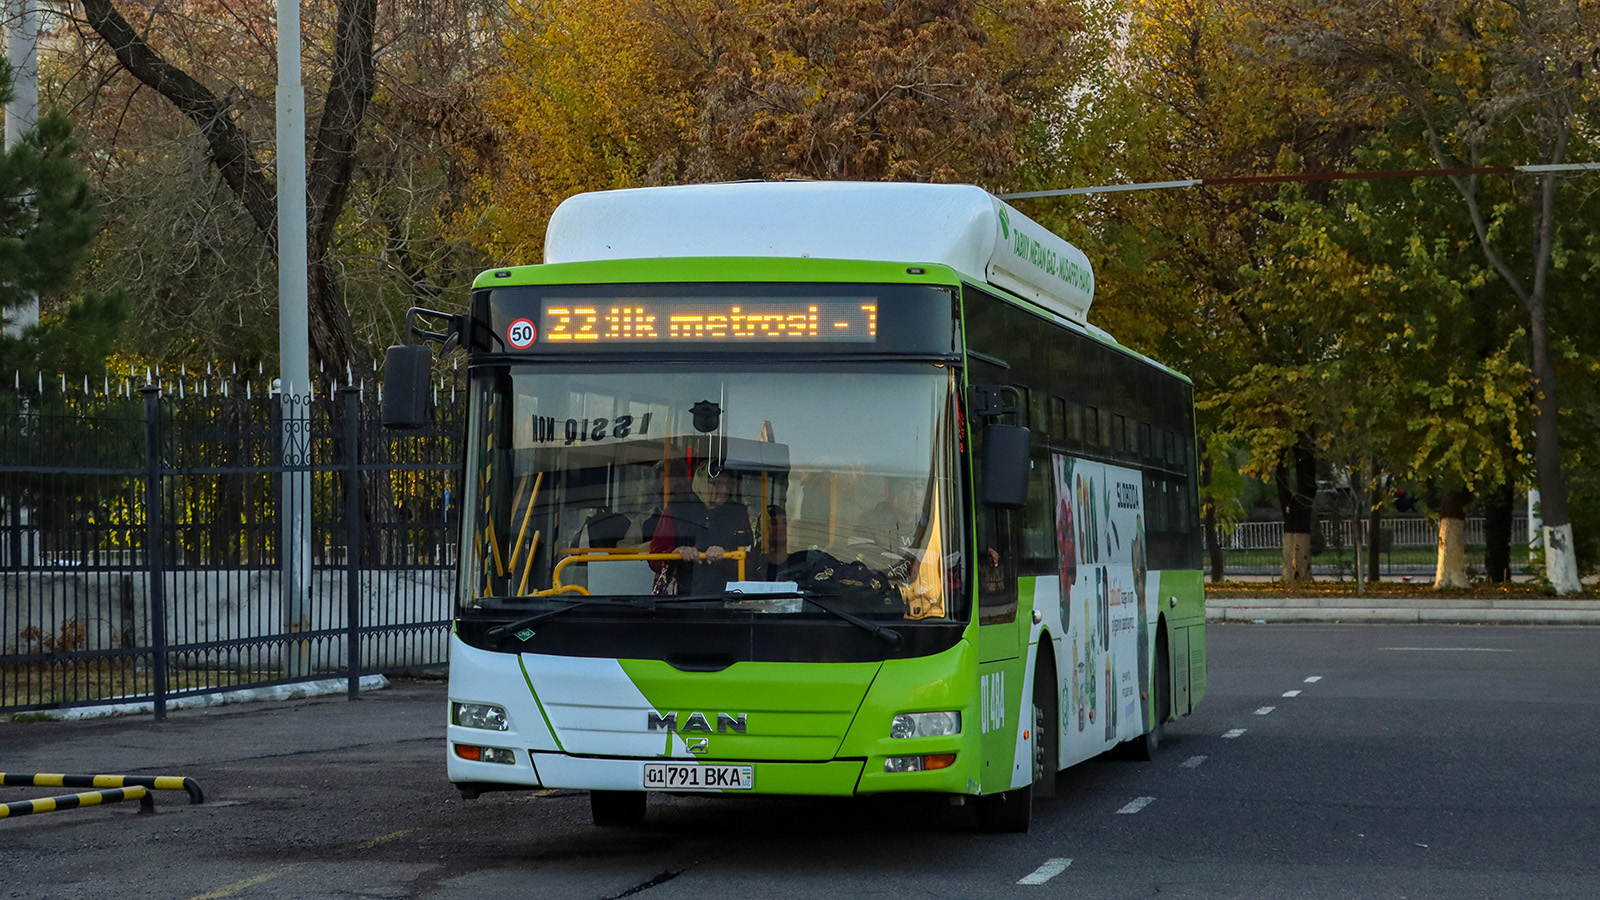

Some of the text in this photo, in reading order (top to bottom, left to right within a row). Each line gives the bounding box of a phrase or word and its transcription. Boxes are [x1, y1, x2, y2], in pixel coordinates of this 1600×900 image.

[512, 325, 532, 342] 50
[547, 307, 598, 339] 22
[670, 306, 818, 336] metrosi
[1116, 481, 1140, 510] SLOBODA
[990, 671, 1005, 731] 484
[647, 711, 748, 733] MAN
[648, 767, 741, 786] 01 791 BKA
[742, 779, 751, 787] UZ
